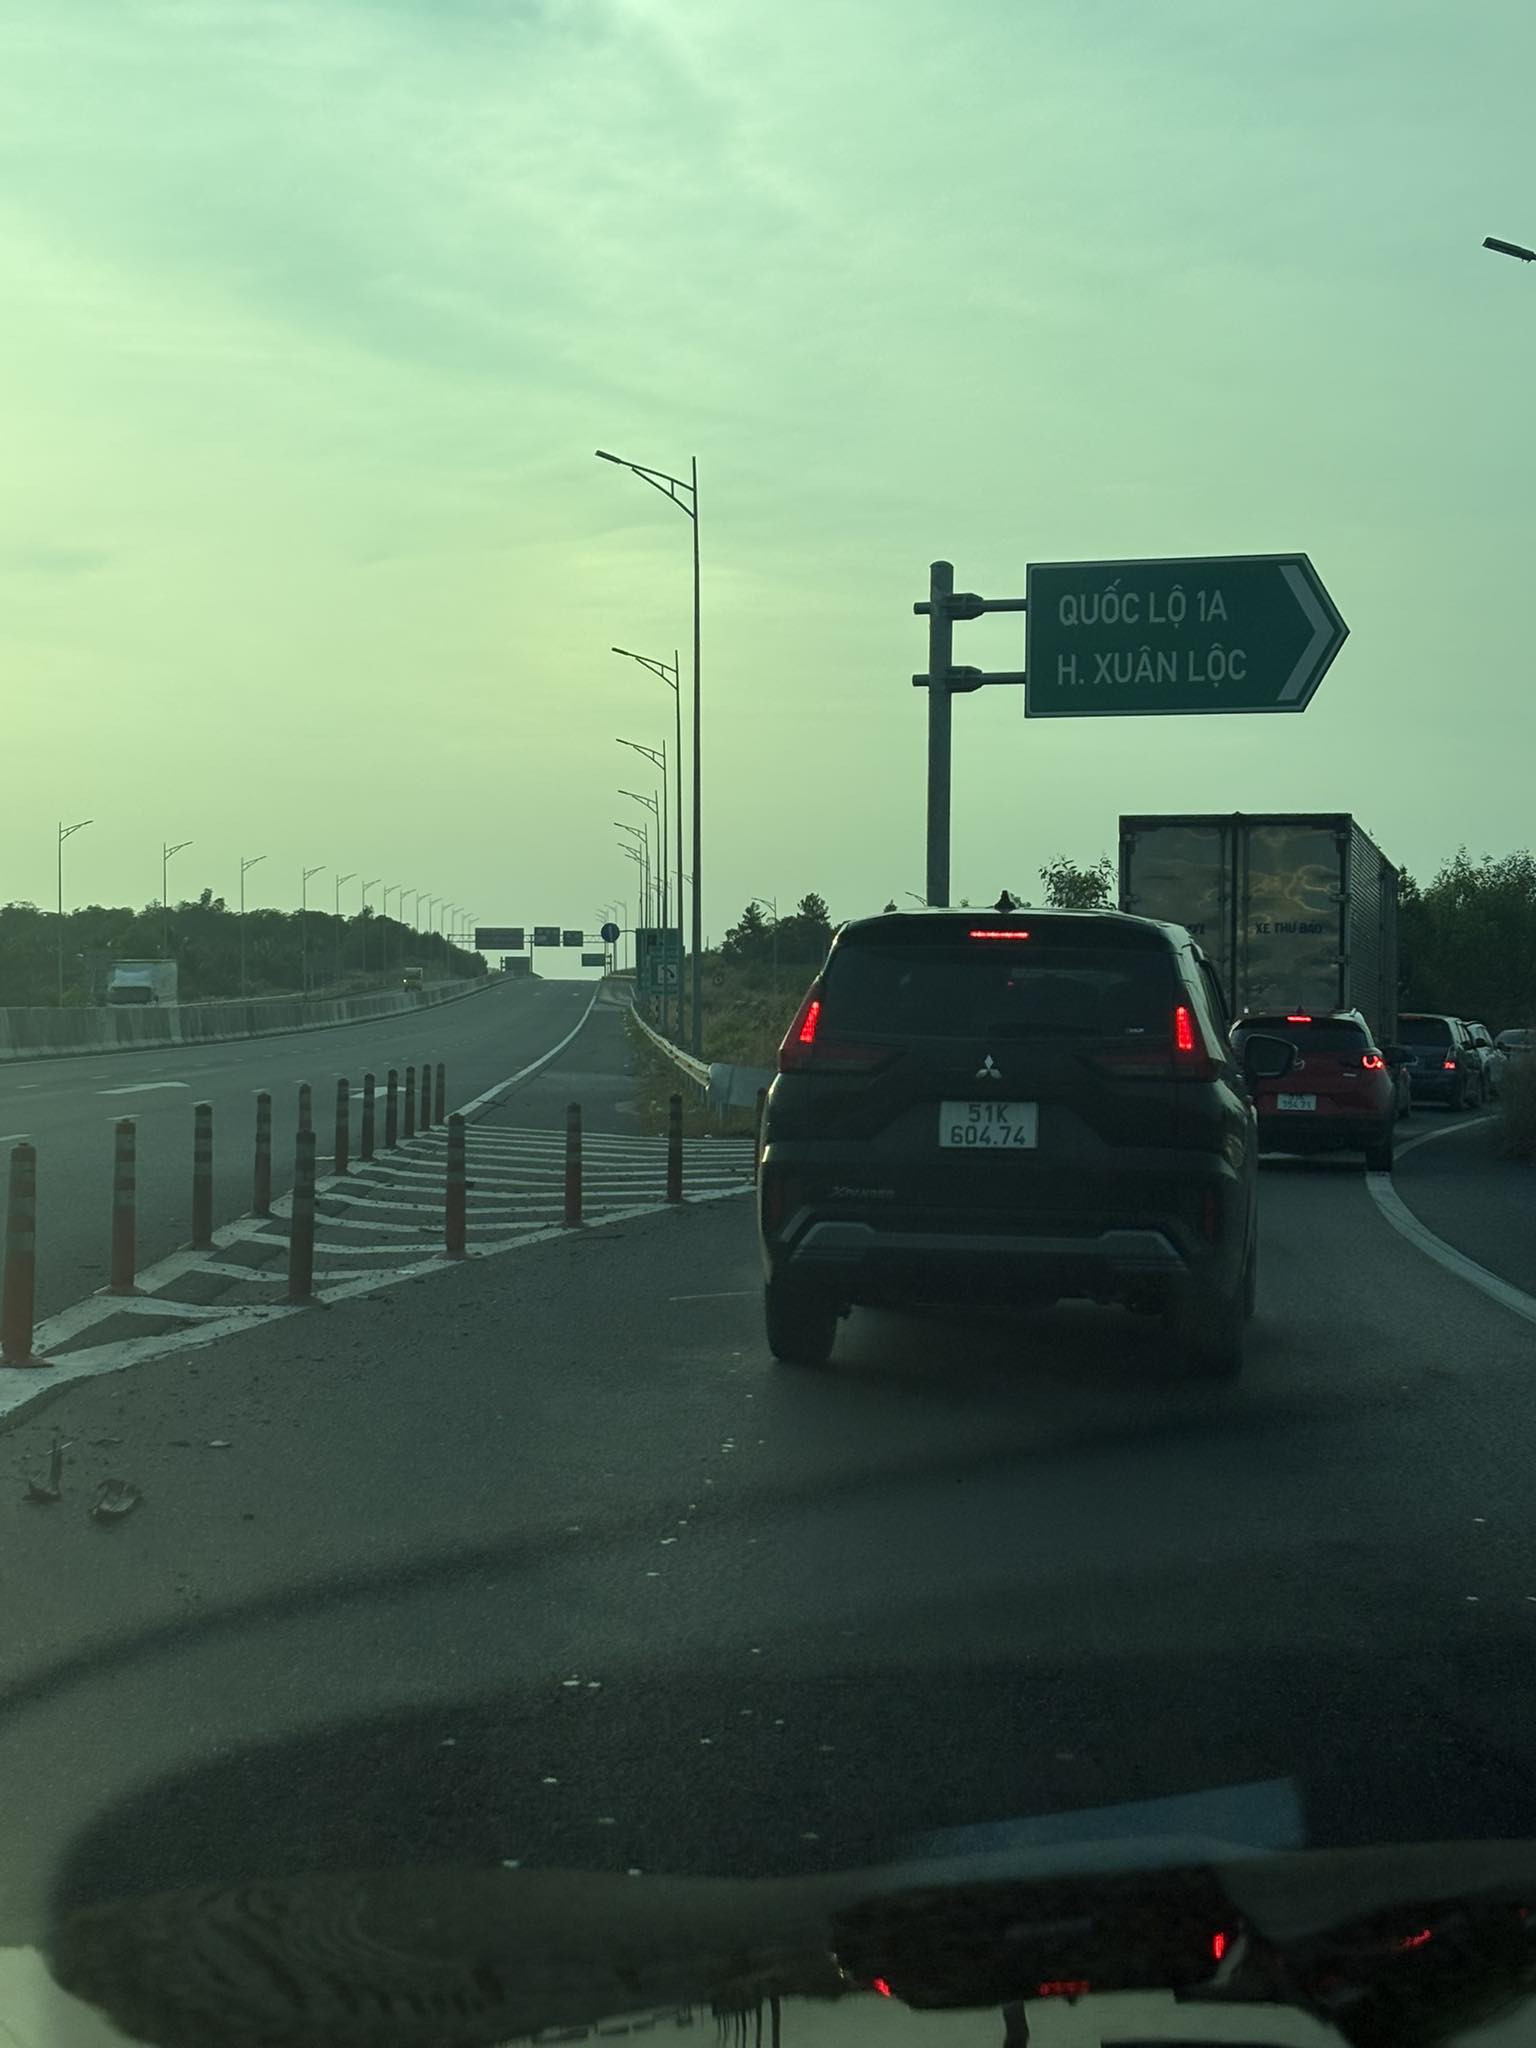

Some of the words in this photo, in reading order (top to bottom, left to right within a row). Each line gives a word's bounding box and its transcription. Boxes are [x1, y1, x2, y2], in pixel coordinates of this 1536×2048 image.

[1058, 578, 1139, 627] QUỐC
[1148, 584, 1187, 628] LỘ
[1197, 588, 1228, 622] 1A
[1057, 653, 1084, 686] H.
[1094, 645, 1177, 685] XUÂN
[1188, 642, 1248, 688] LỘC
[1255, 921, 1271, 935] XE
[968, 1103, 1009, 1123] 51K
[950, 1125, 1026, 1145] 604.74
